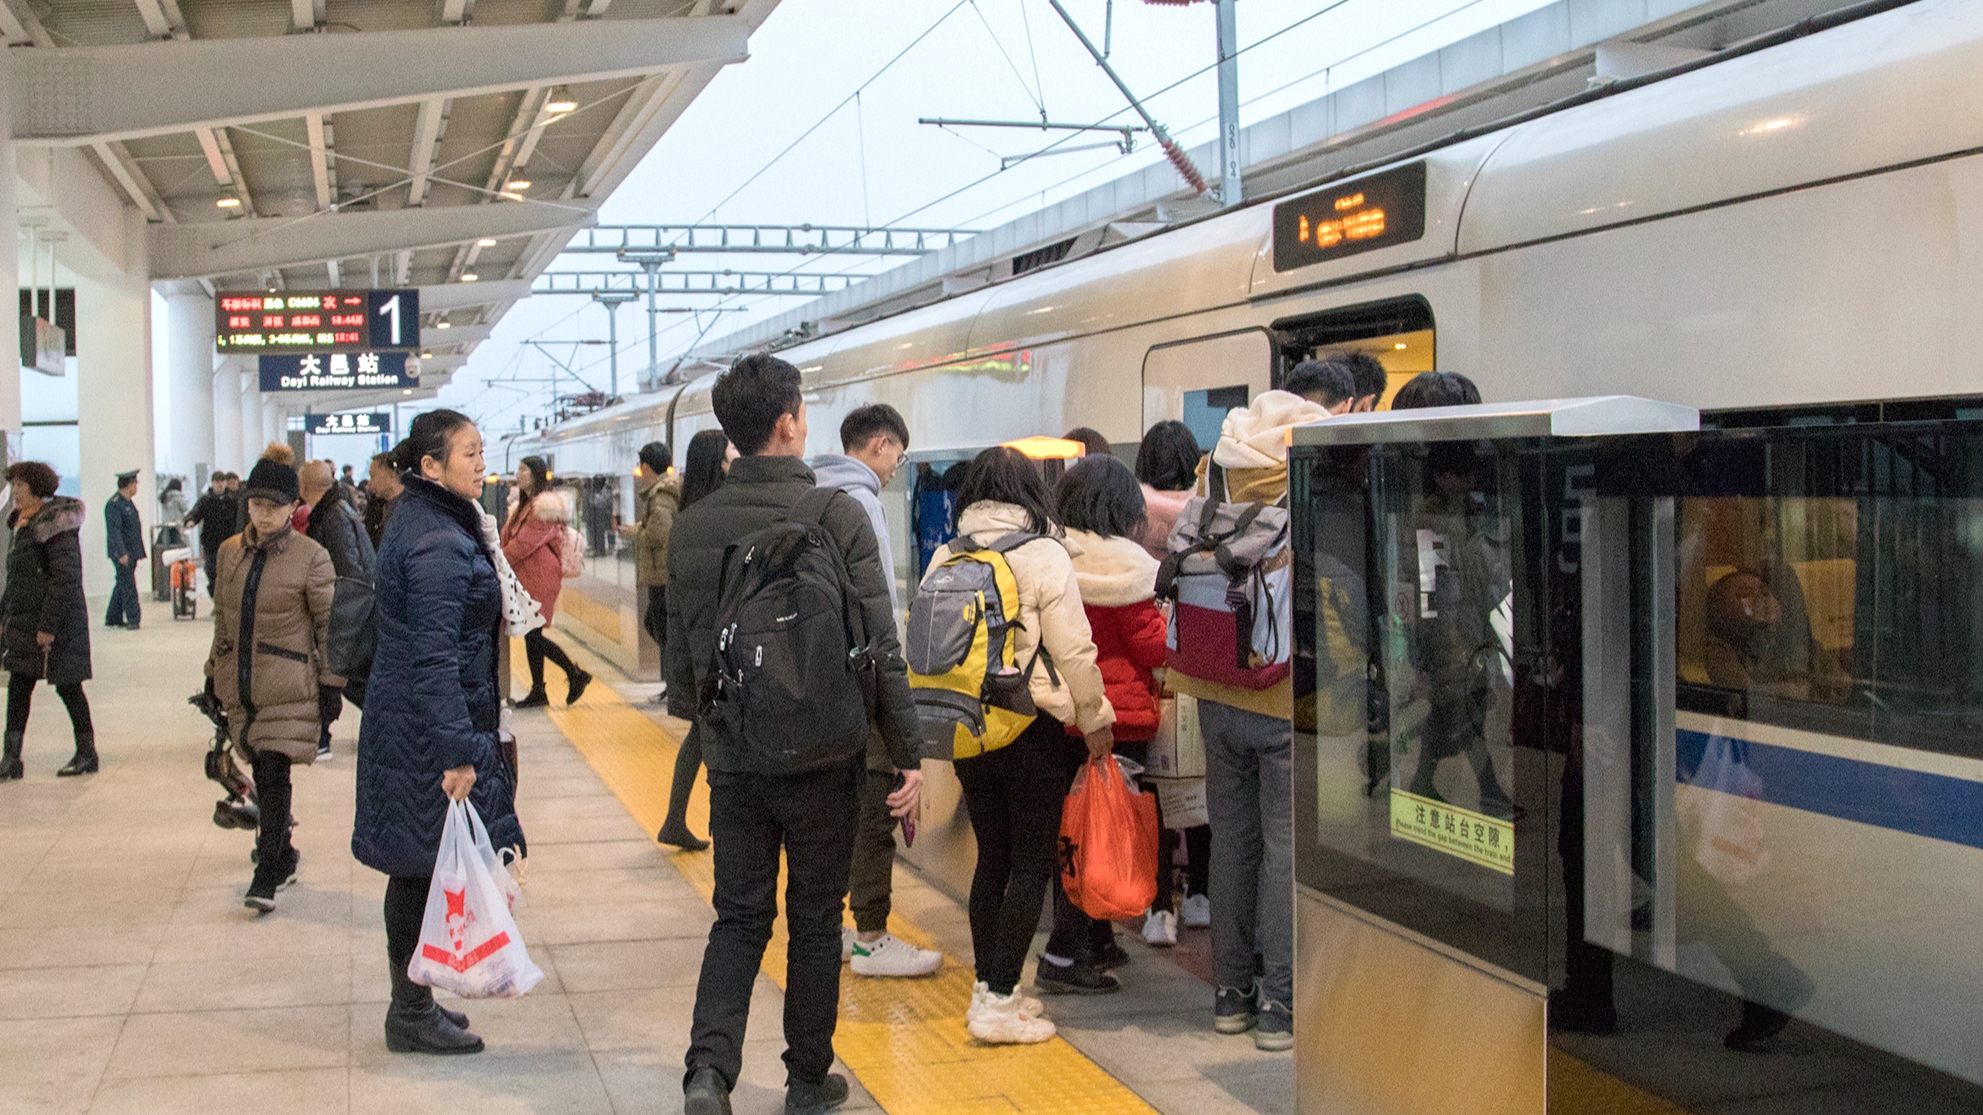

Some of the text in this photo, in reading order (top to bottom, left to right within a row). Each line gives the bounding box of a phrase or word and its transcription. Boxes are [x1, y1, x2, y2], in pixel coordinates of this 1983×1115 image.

[323, 295, 337, 310] 次
[379, 295, 400, 345] 1
[299, 352, 380, 375] 大邑站
[280, 373, 398, 388] Dayi Railway Station
[325, 414, 371, 428] 大邑站
[1396, 818, 1412, 830] Please
[1413, 824, 1427, 836] mind
[1427, 829, 1437, 839] the
[1437, 833, 1448, 844] gap
[1449, 836, 1473, 850] between
[1474, 843, 1483, 853] the
[1484, 847, 1498, 859] train
